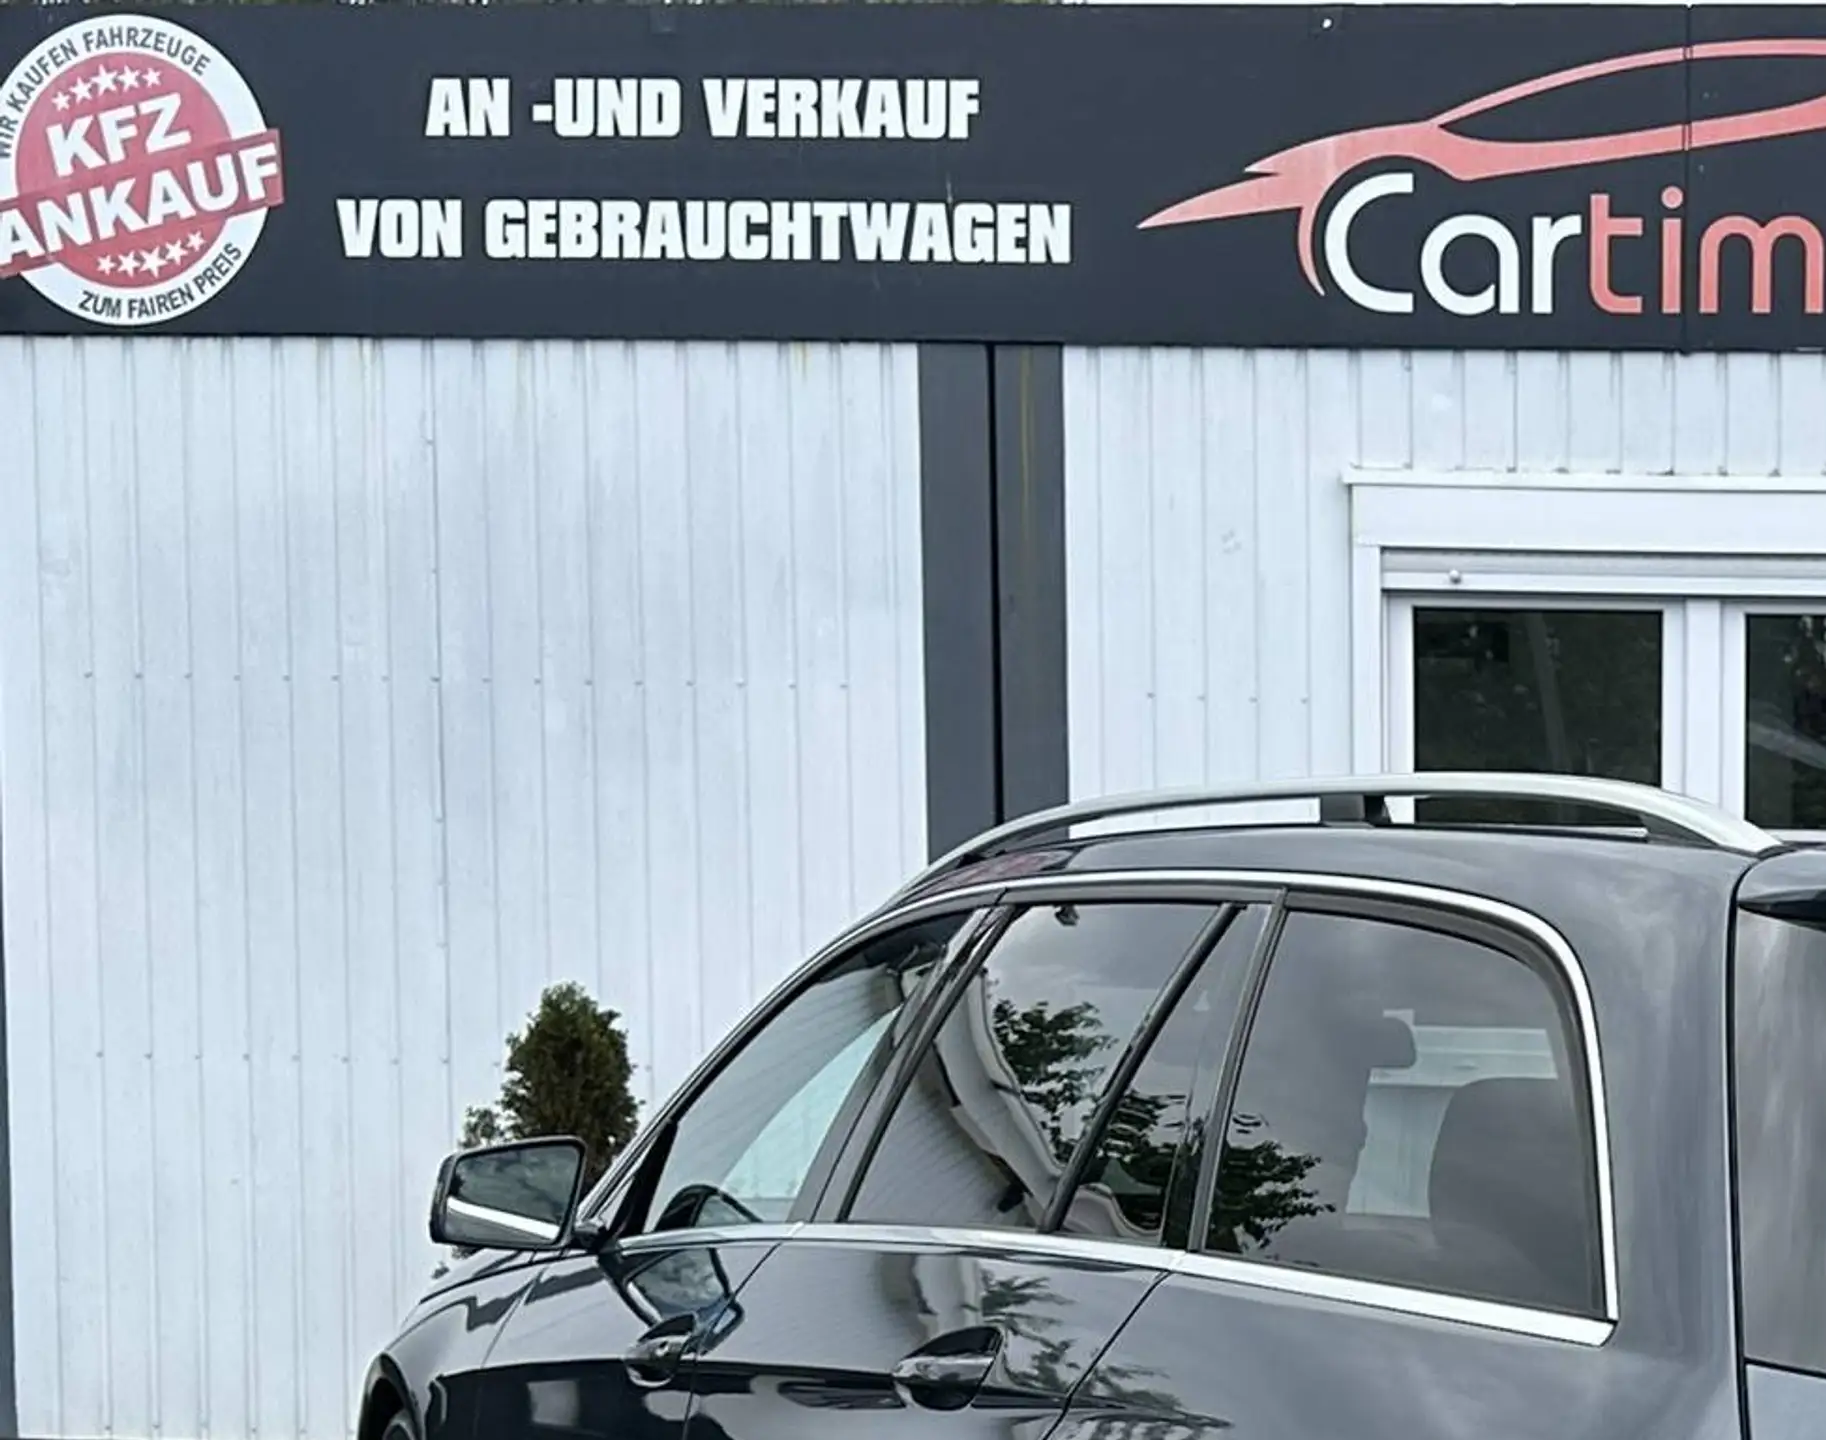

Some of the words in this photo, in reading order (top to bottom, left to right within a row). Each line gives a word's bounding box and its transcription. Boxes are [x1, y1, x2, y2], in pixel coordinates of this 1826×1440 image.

[6, 38, 79, 113] KAUFEN
[82, 25, 211, 76] FAHRZEUGE
[425, 77, 510, 137] AN
[702, 79, 980, 139] VERKAUF
[46, 91, 192, 178] KFZ
[0, 142, 279, 266] ANKAUF
[336, 198, 463, 258] VON
[485, 199, 1072, 263] GEBRAUCHTWAGEN
[78, 290, 122, 319] ZUM
[127, 283, 195, 319] FAIREN
[192, 243, 242, 295] PREIS
